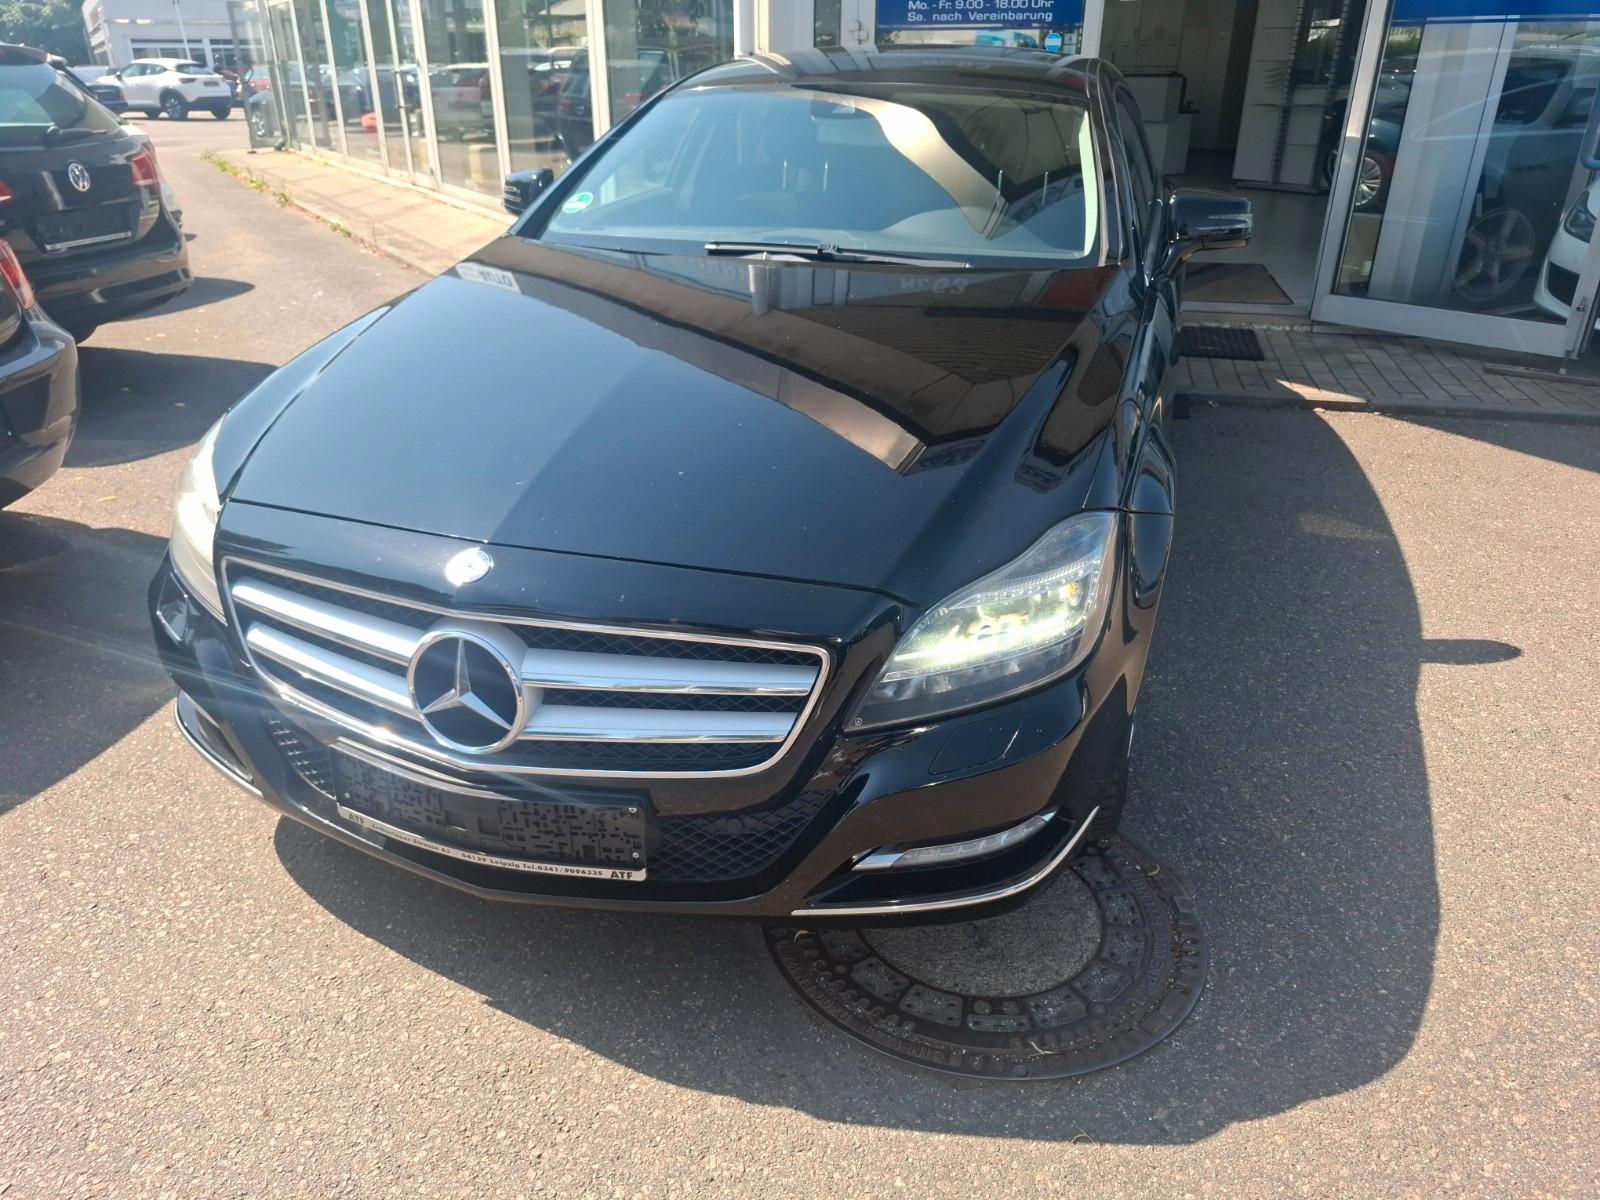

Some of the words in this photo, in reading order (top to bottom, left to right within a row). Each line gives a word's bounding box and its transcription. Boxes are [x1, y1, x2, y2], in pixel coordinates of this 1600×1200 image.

[908, 0, 929, 10] Mo.
[939, 0, 952, 9] Fr.
[955, 0, 983, 9] 9.00
[996, 0, 1028, 9] 18.00
[1031, 0, 1053, 8] Uhr
[907, 12, 926, 21] Sa.
[932, 12, 962, 21] nach
[969, 11, 1053, 22] Vereinbarung
[490, 858, 520, 869] Leipzig
[610, 871, 633, 880] ATF
